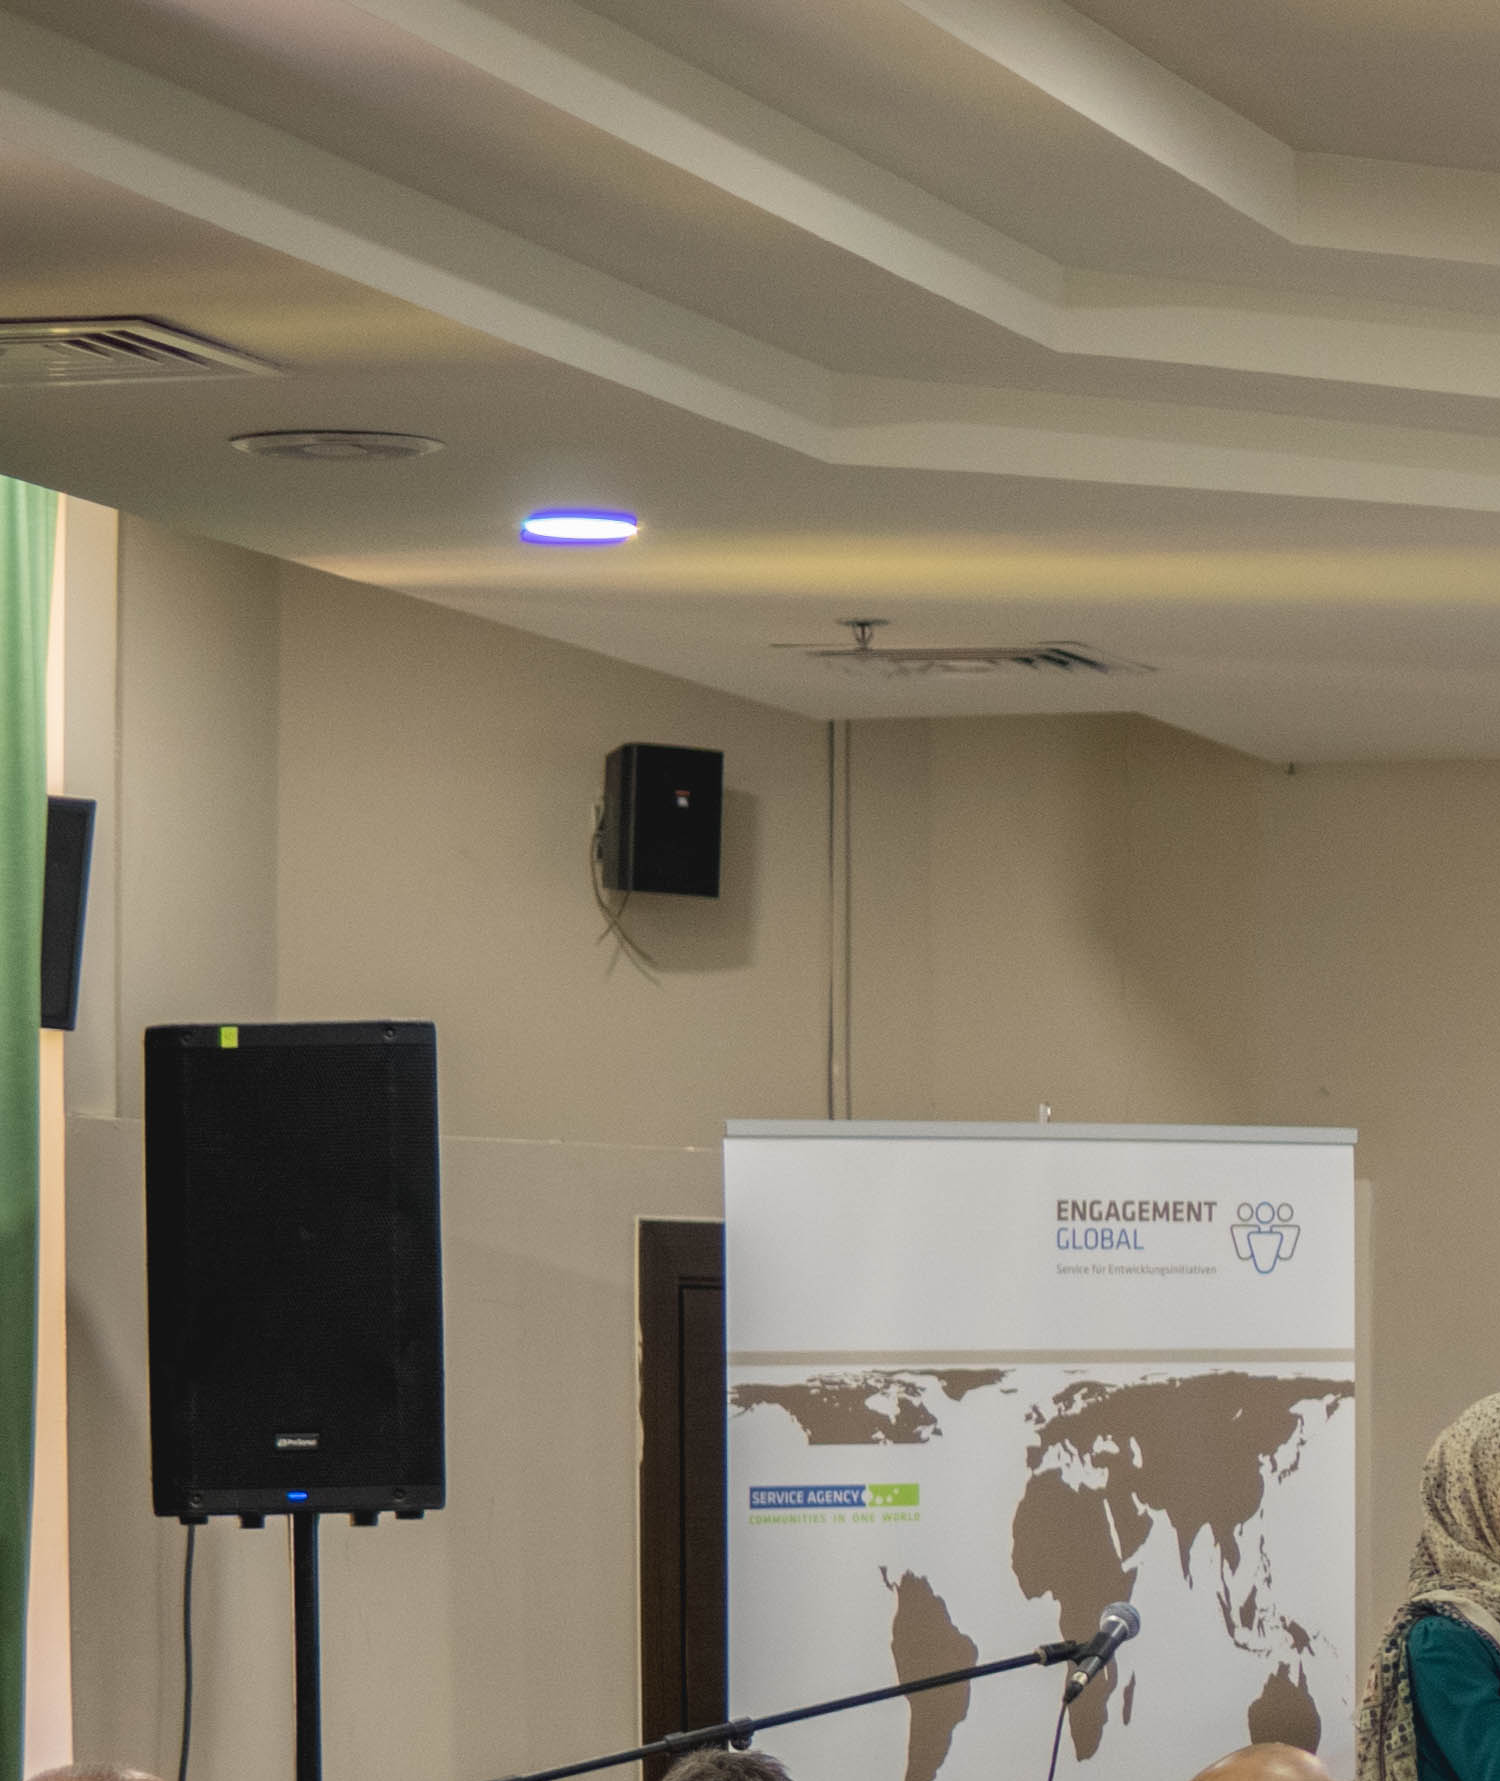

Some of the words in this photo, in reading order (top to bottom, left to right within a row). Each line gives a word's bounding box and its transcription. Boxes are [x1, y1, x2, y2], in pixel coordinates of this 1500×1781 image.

[1056, 1199, 1218, 1222] ENGAGEMENT
[1056, 1227, 1145, 1250] GLOBAL
[1056, 1263, 1089, 1275] Service
[751, 1489, 804, 1505] SERVICE
[807, 1489, 860, 1505] AGENCY
[750, 1513, 826, 1525] COMMUNITIES
[852, 1512, 875, 1523] ONE
[881, 1511, 921, 1522] WORLD
